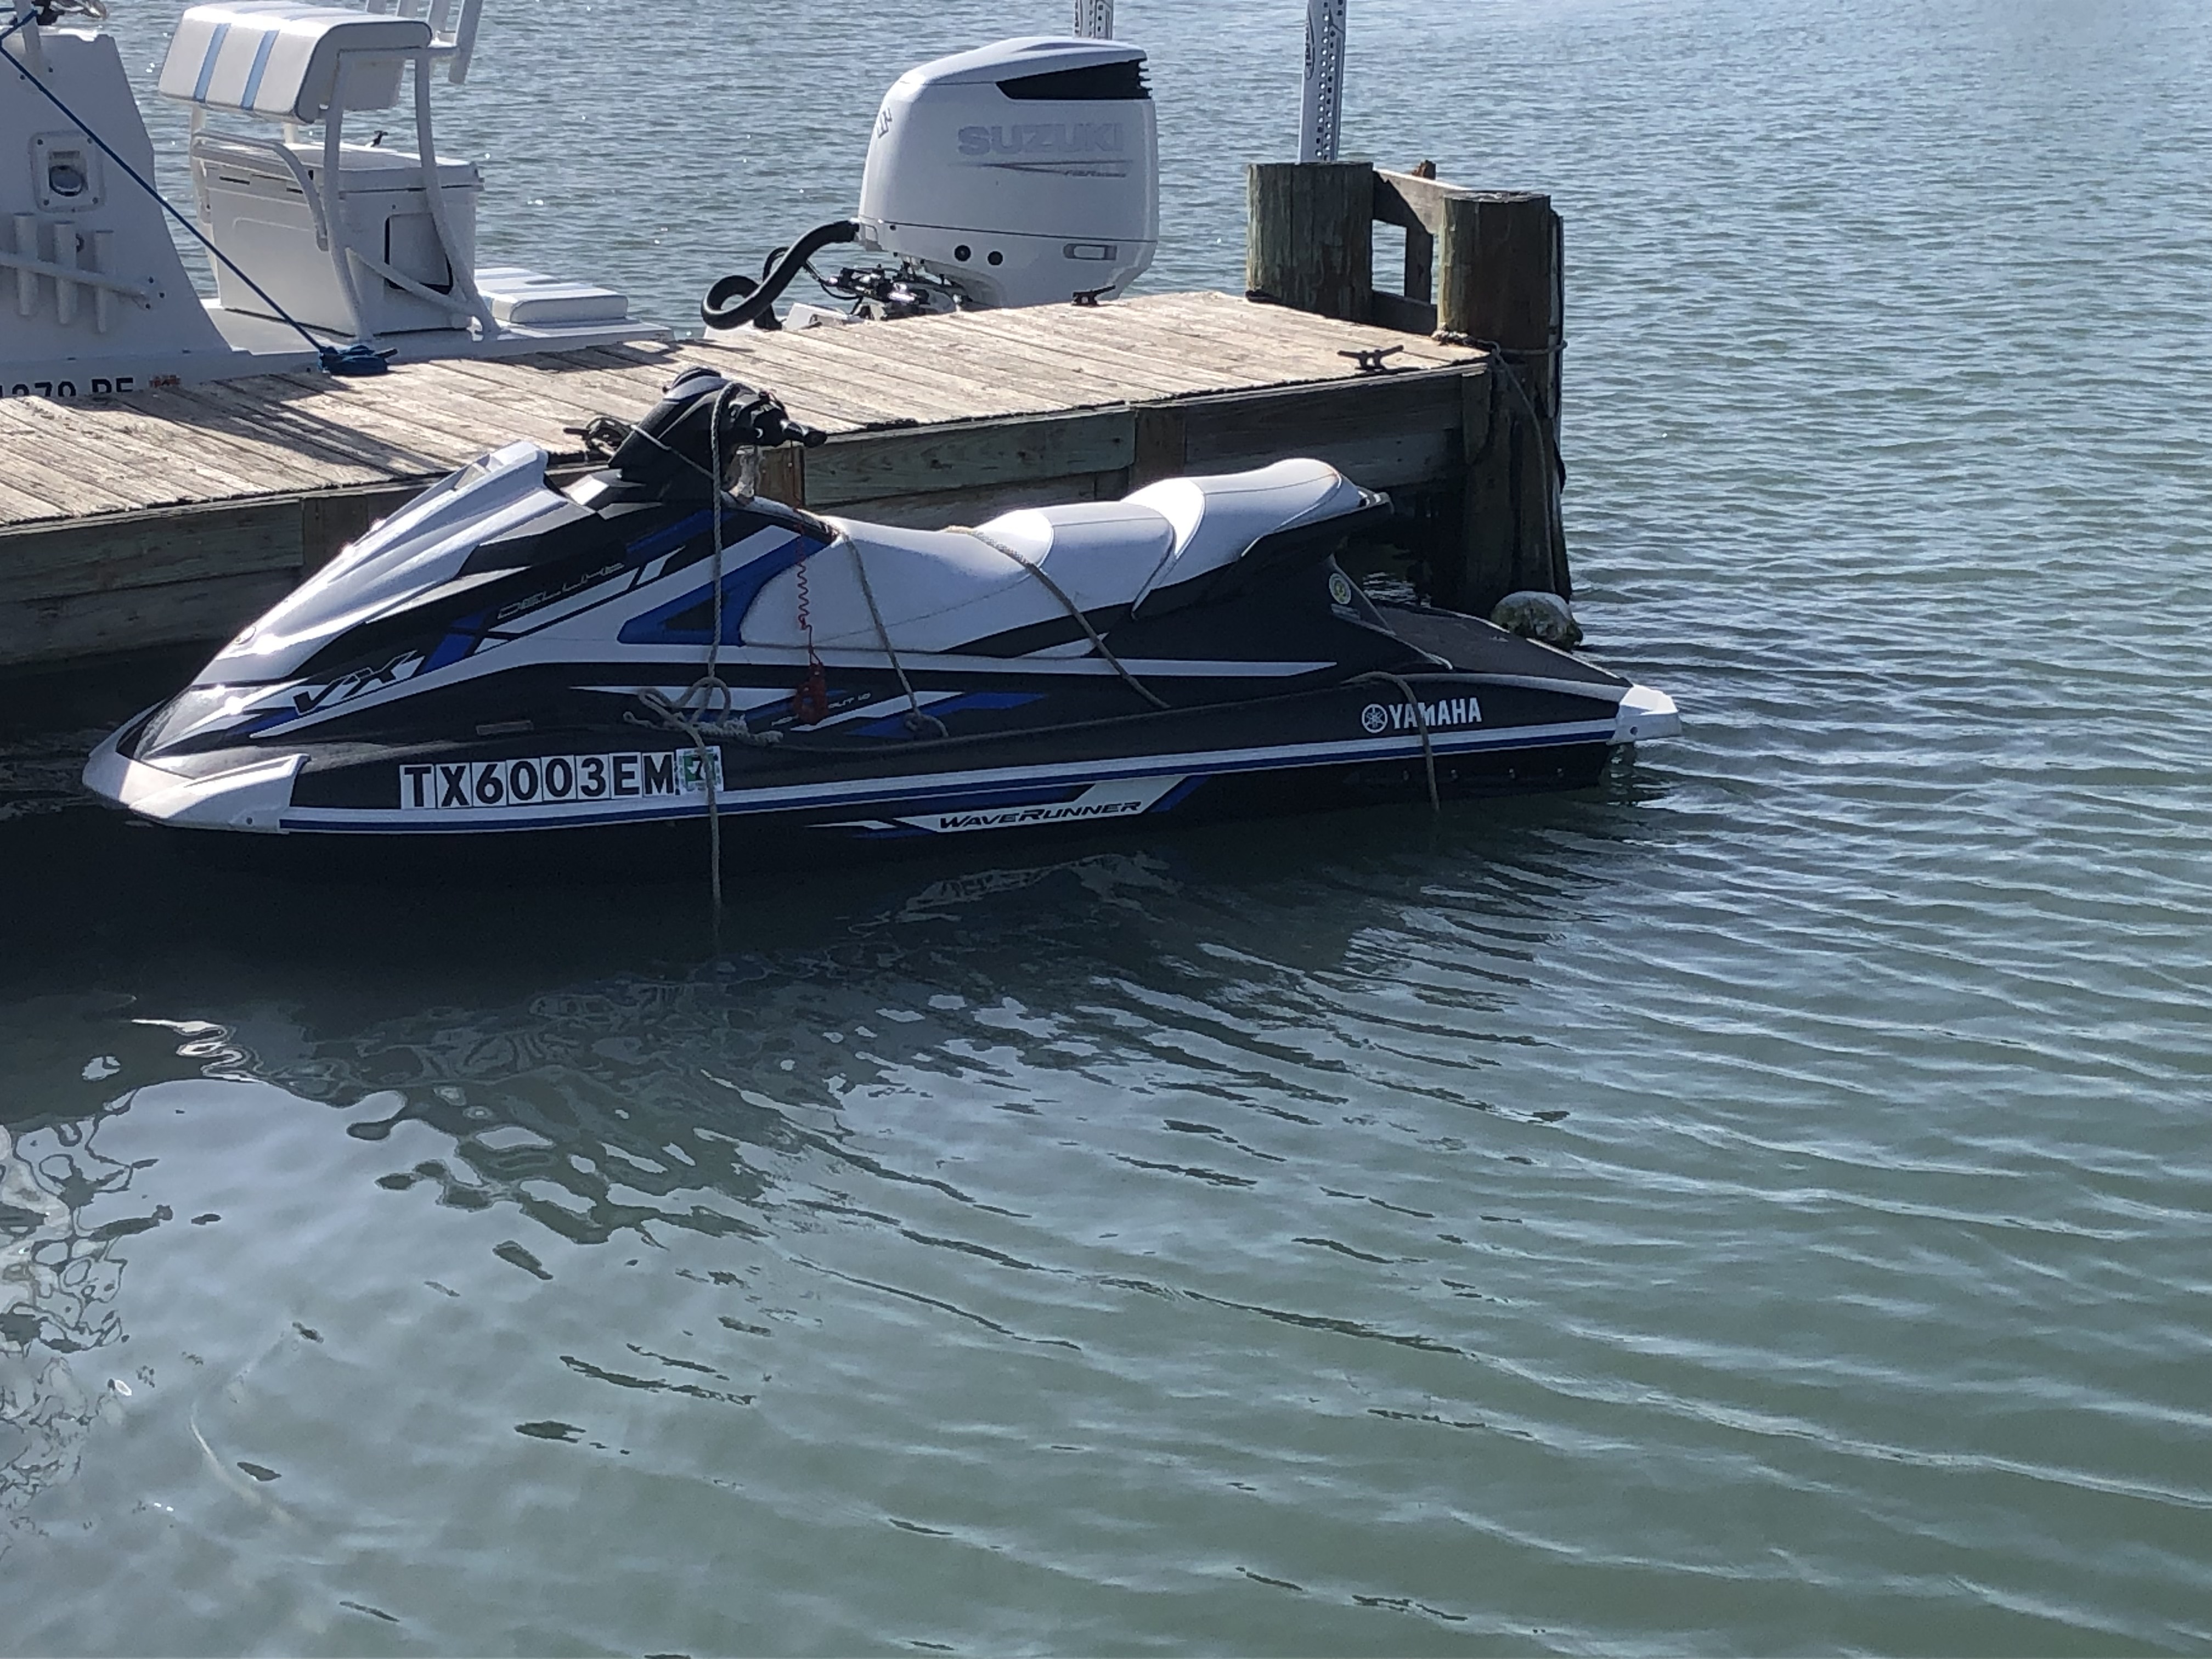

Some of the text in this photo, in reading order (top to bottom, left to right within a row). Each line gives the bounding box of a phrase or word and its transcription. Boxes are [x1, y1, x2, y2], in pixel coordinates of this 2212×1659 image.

[958, 123, 1125, 155] SUZUKI
[293, 650, 419, 716] VX
[1388, 697, 1482, 730] YAMAHA
[404, 754, 674, 808] TX6003EM
[939, 801, 1142, 829] WAVERUNNER
